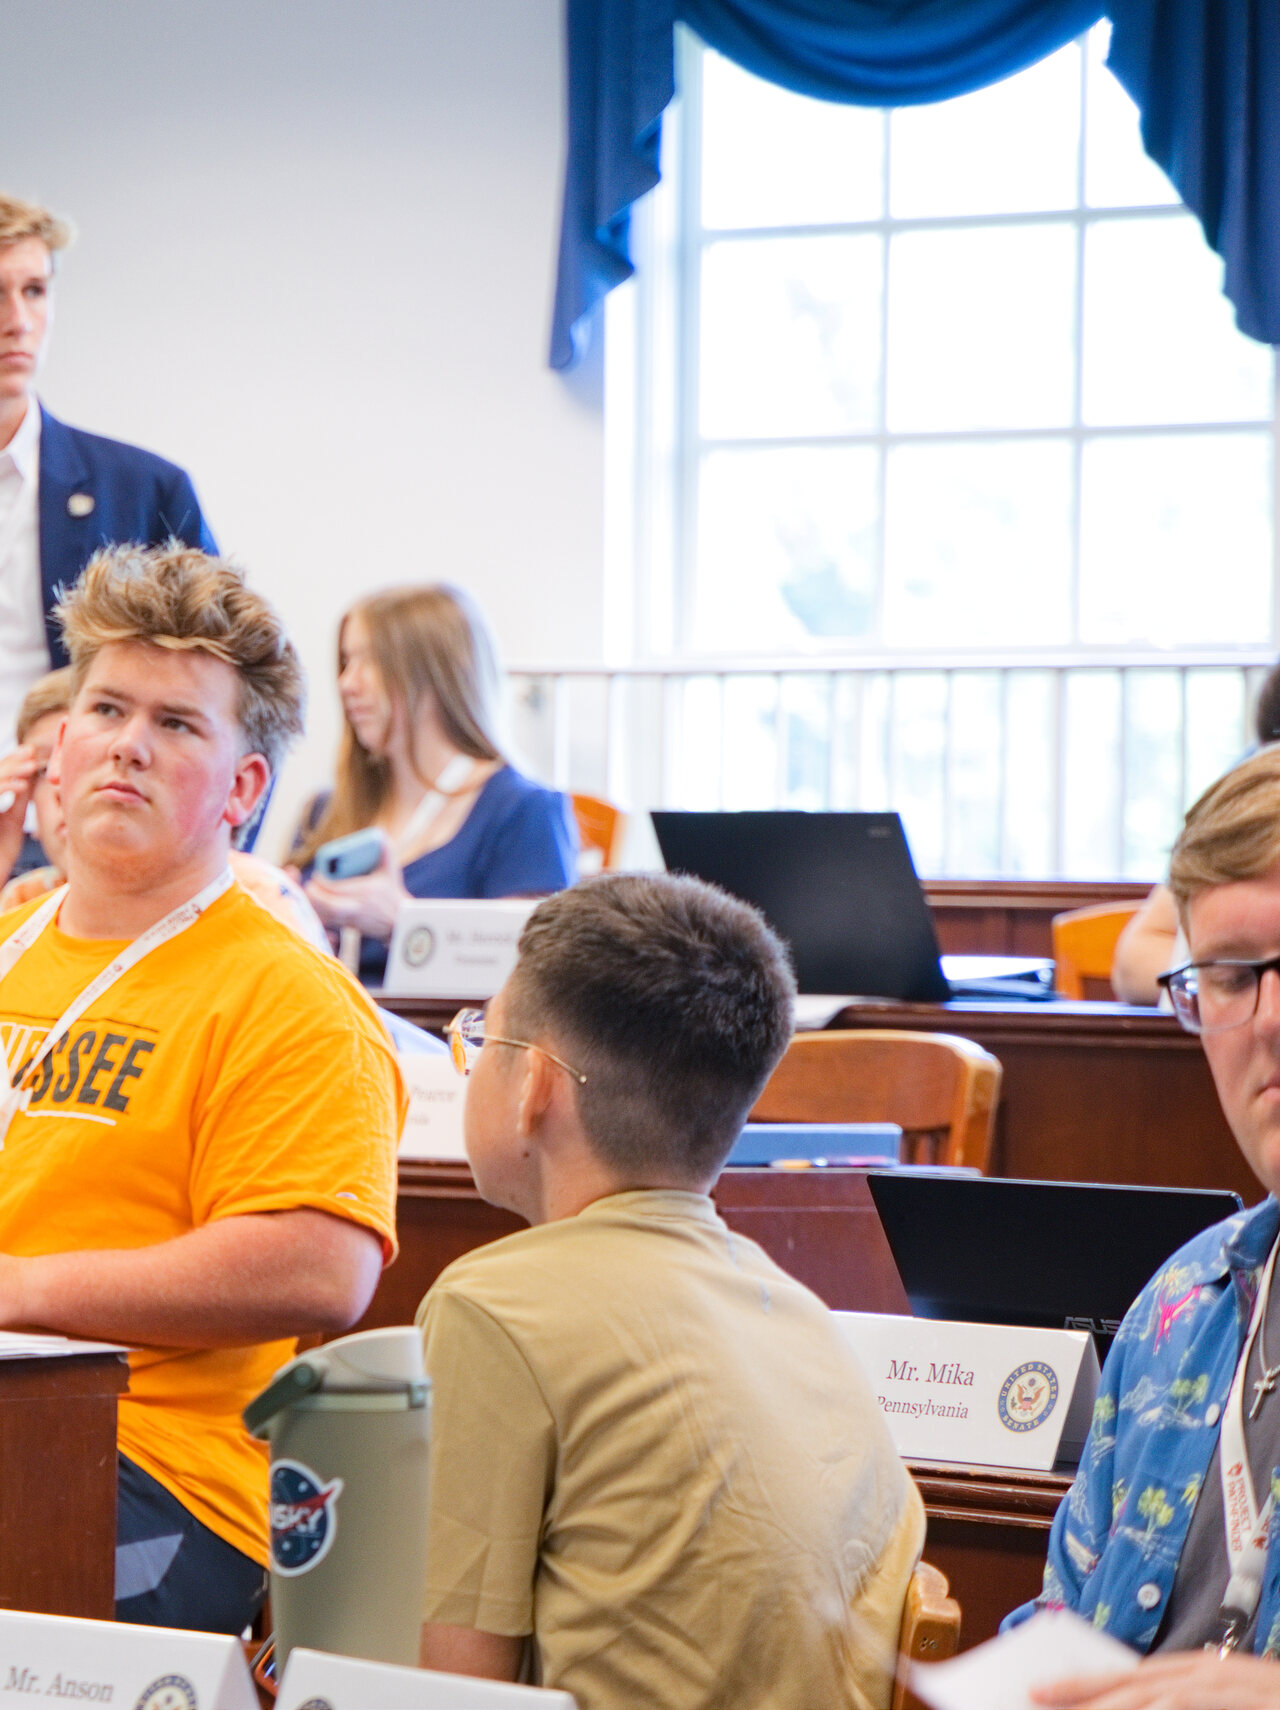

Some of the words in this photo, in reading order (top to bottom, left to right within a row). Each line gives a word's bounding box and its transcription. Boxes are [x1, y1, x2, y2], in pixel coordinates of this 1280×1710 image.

[885, 1359, 920, 1381] Mr.
[924, 1362, 975, 1387] Mika
[1000, 1363, 1034, 1398] UNITED
[1036, 1363, 1058, 1401] STATES
[877, 1395, 970, 1420] Pennsylvania
[1001, 1413, 1041, 1431] SENATE
[3, 1665, 40, 1693] Mr.
[45, 1672, 115, 1703] Anson
